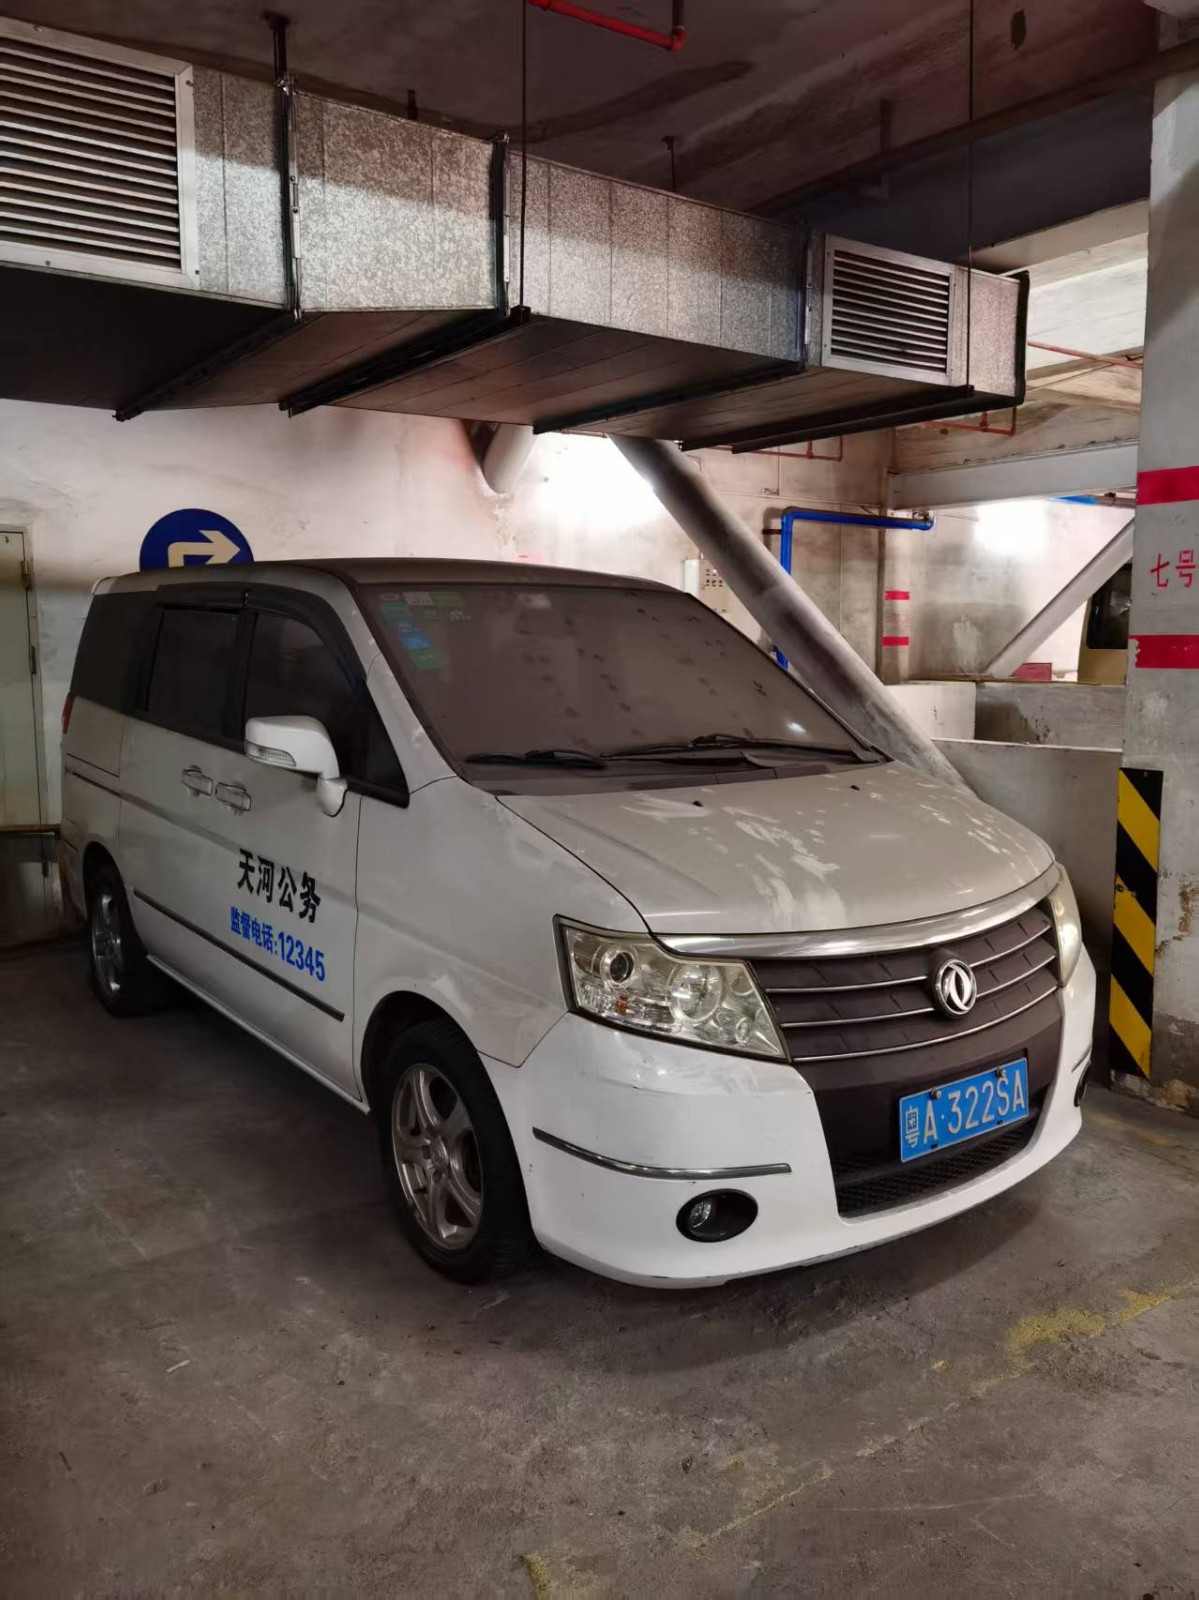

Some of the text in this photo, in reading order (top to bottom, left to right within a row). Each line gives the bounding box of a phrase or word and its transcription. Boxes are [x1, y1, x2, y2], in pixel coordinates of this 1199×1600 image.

[1149, 550, 1196, 588] 七号
[237, 848, 322, 924] 天河公务
